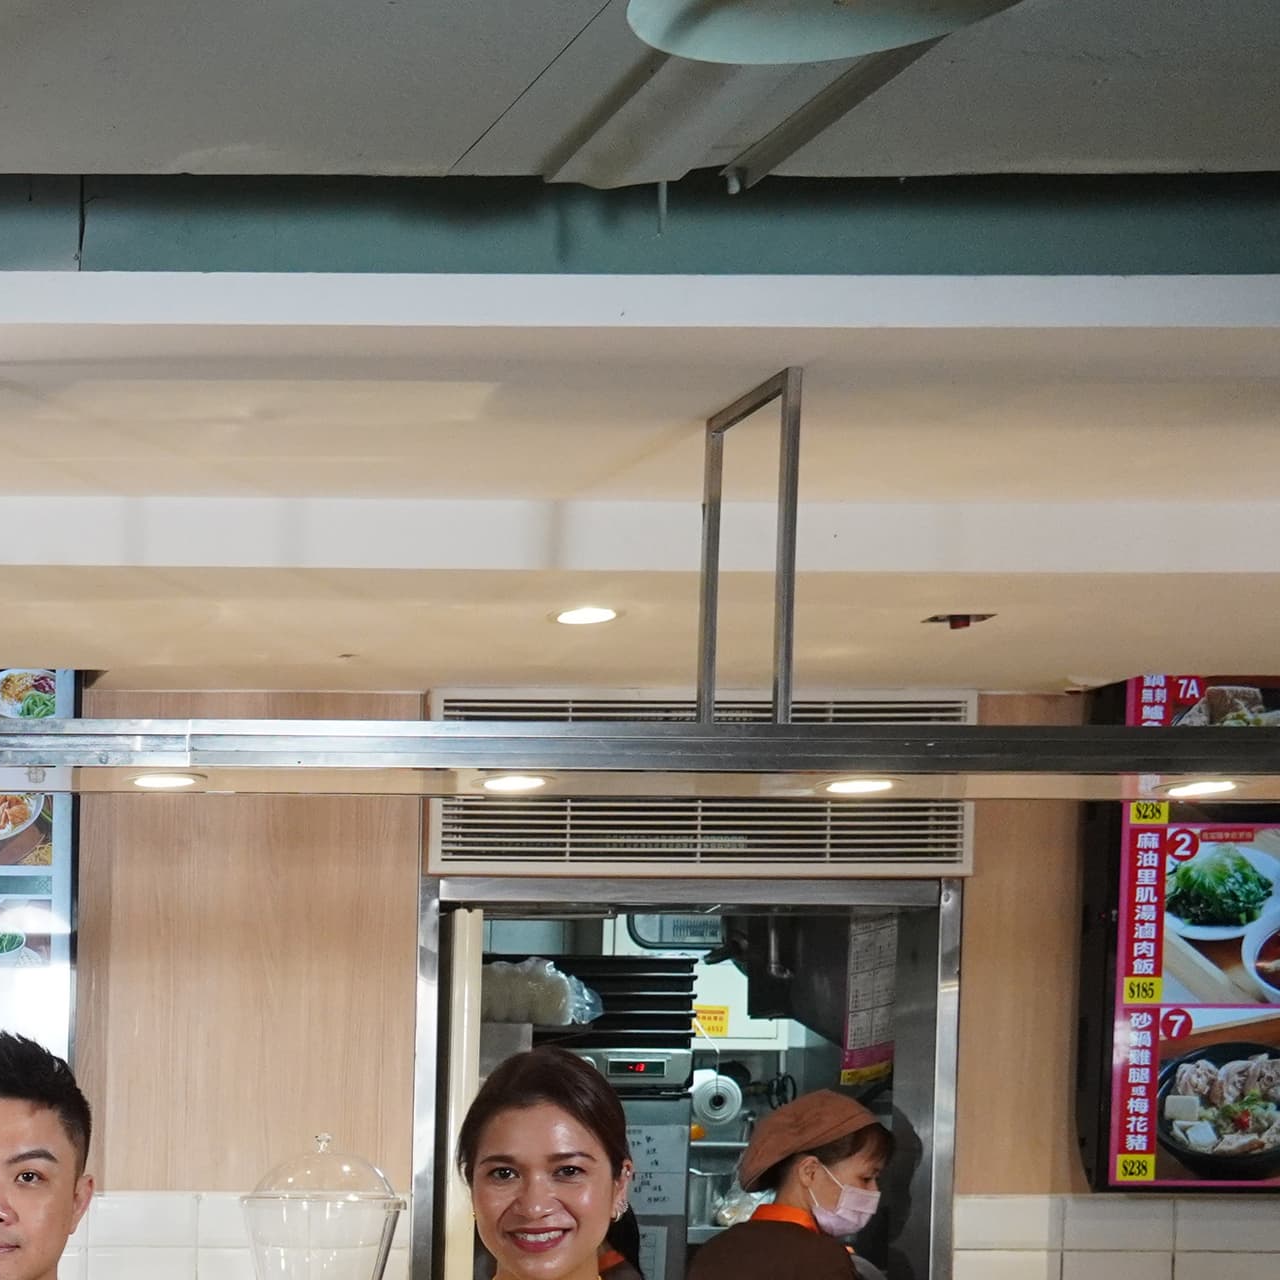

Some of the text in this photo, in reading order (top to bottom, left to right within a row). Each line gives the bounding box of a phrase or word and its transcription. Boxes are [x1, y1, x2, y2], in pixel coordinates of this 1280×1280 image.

[1178, 679, 1200, 698] 7A
[1128, 981, 1155, 1000] $185
[1121, 1159, 1148, 1177] $238
